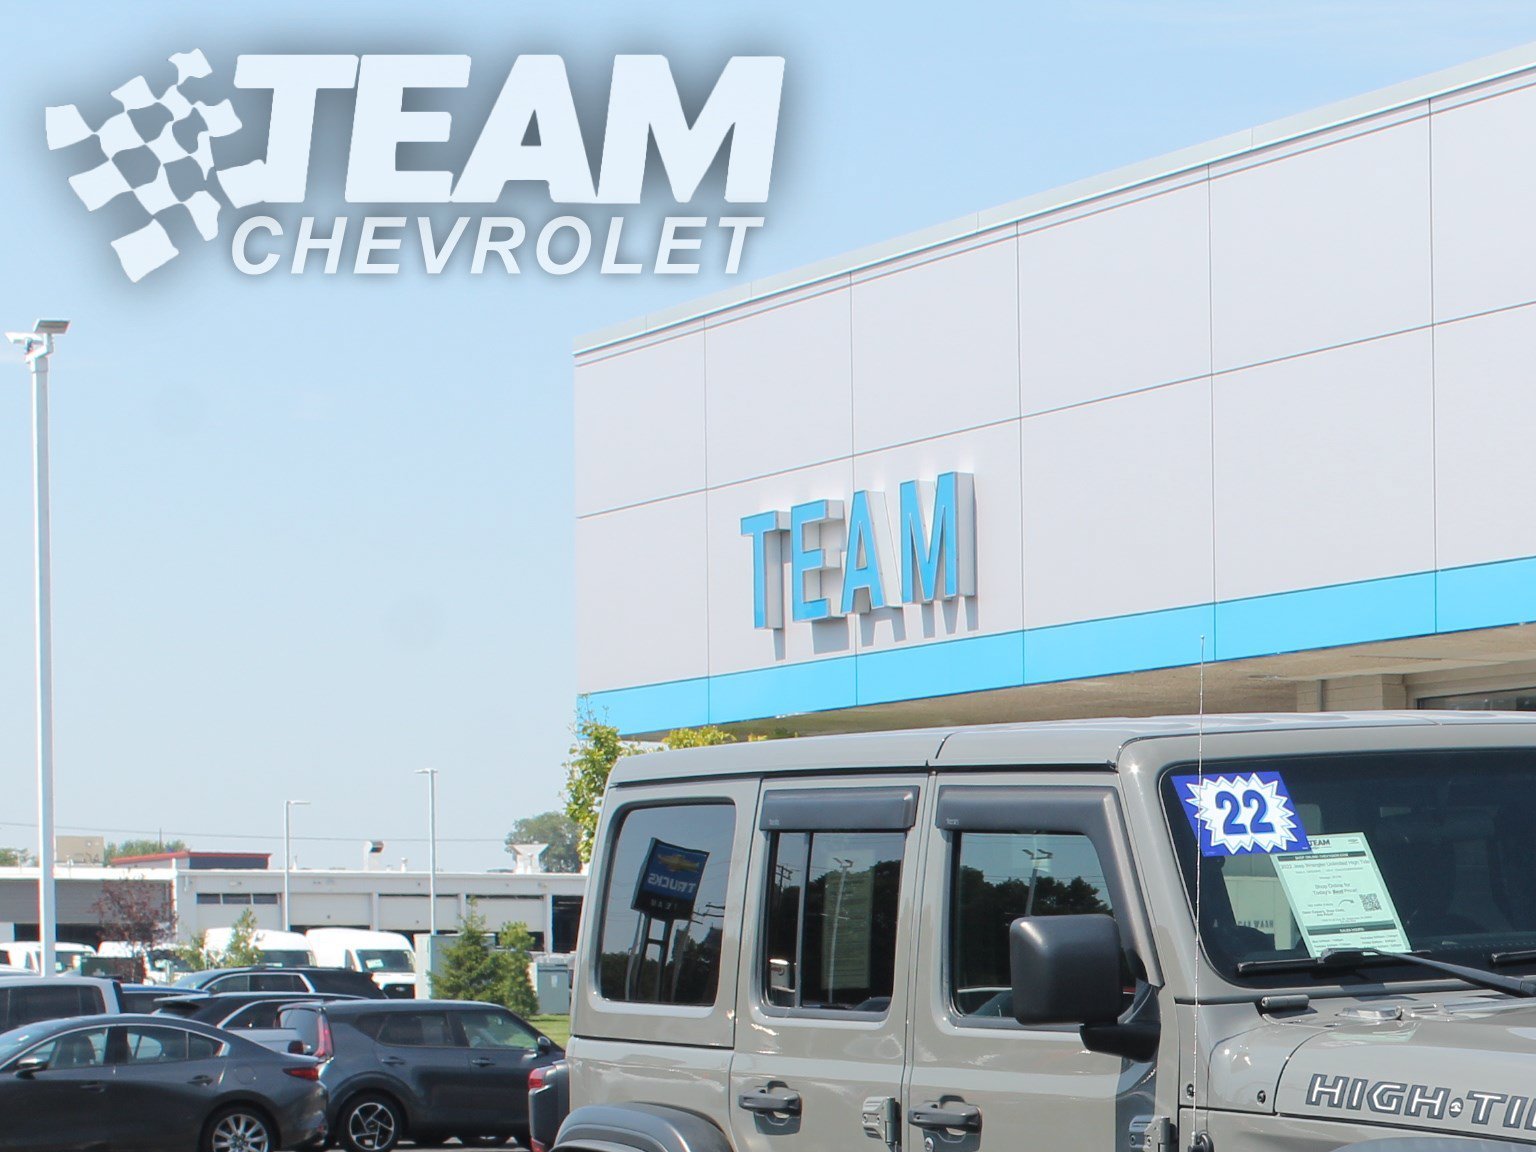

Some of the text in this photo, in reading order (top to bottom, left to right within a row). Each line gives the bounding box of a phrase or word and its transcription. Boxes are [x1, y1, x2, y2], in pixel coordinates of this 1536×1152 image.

[740, 471, 976, 630] TEAM
[1214, 788, 1275, 835] 22
[1305, 1072, 1451, 1121] HIGH
